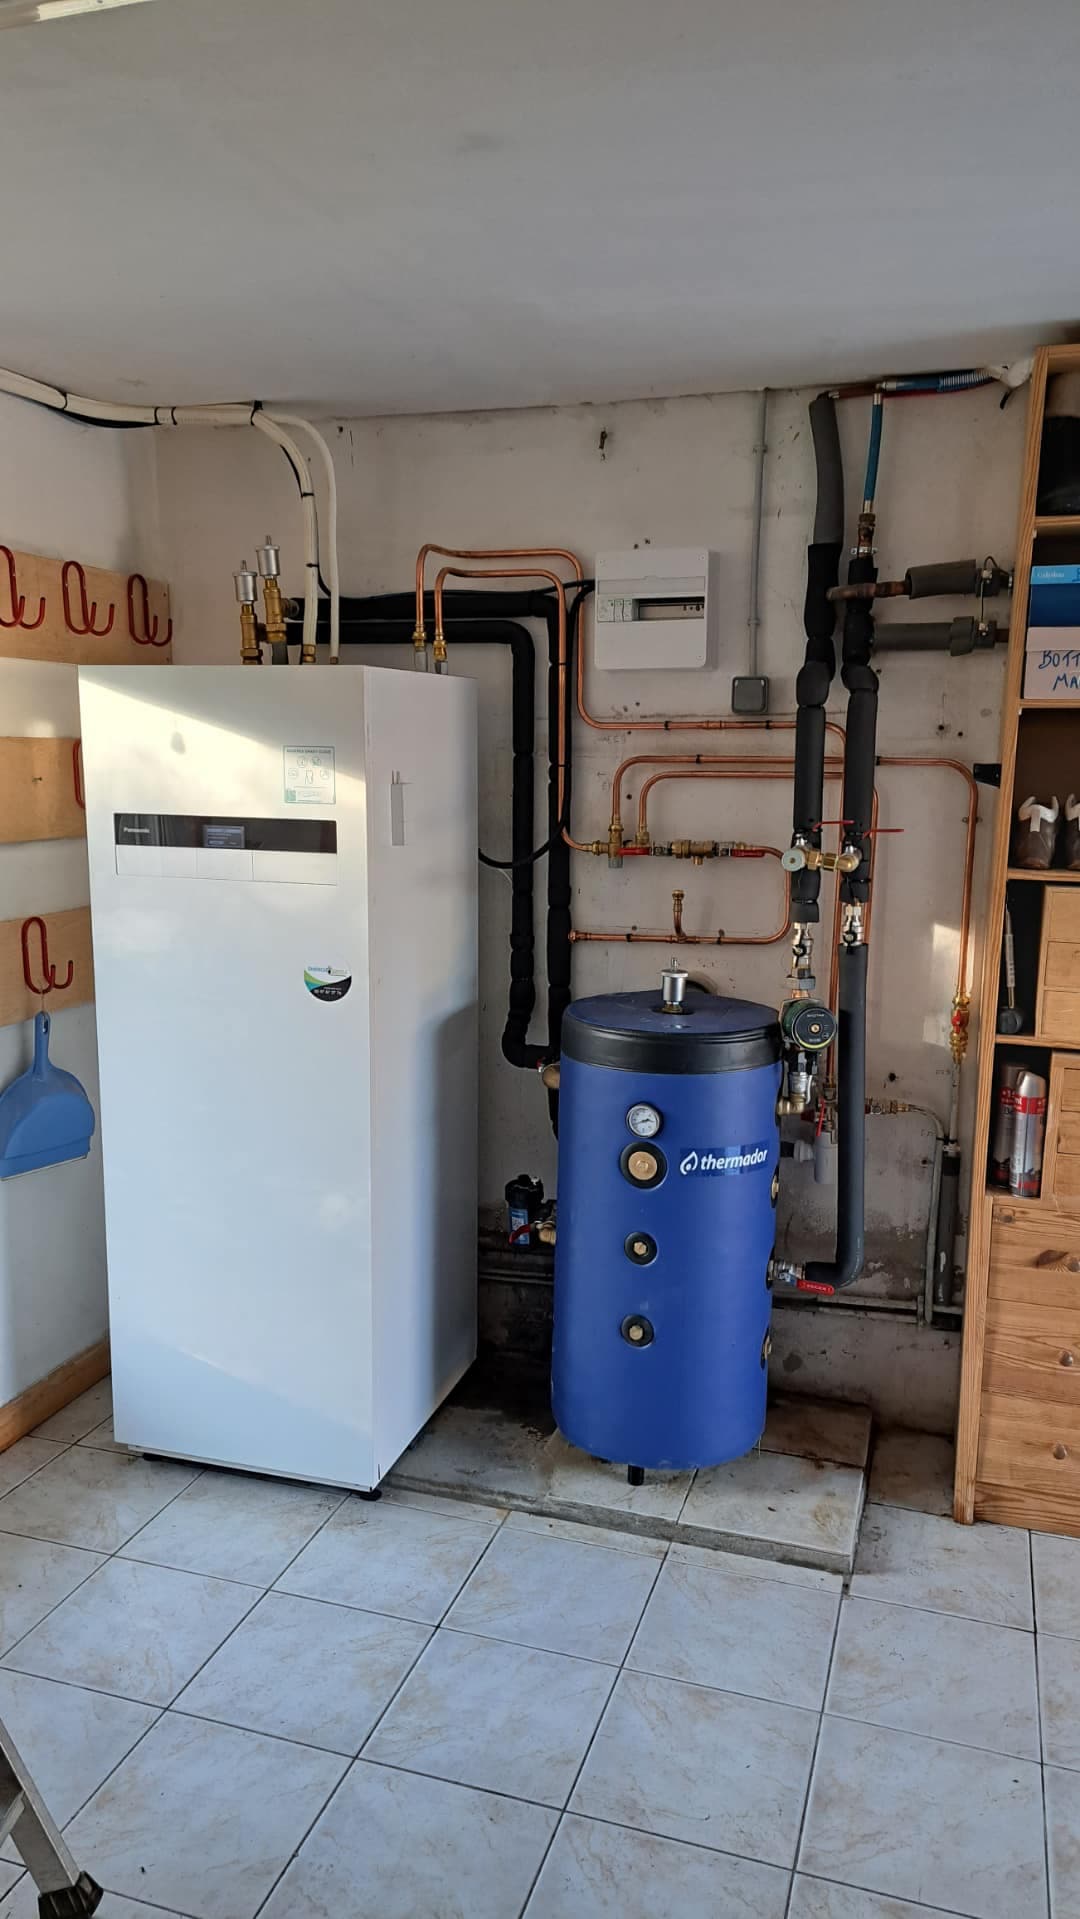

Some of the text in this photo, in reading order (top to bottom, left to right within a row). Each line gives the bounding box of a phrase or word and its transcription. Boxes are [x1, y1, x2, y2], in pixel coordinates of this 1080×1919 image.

[1038, 649, 1080, 669] BOTT
[1052, 672, 1080, 691] MA
[701, 1147, 767, 1170] thermador
